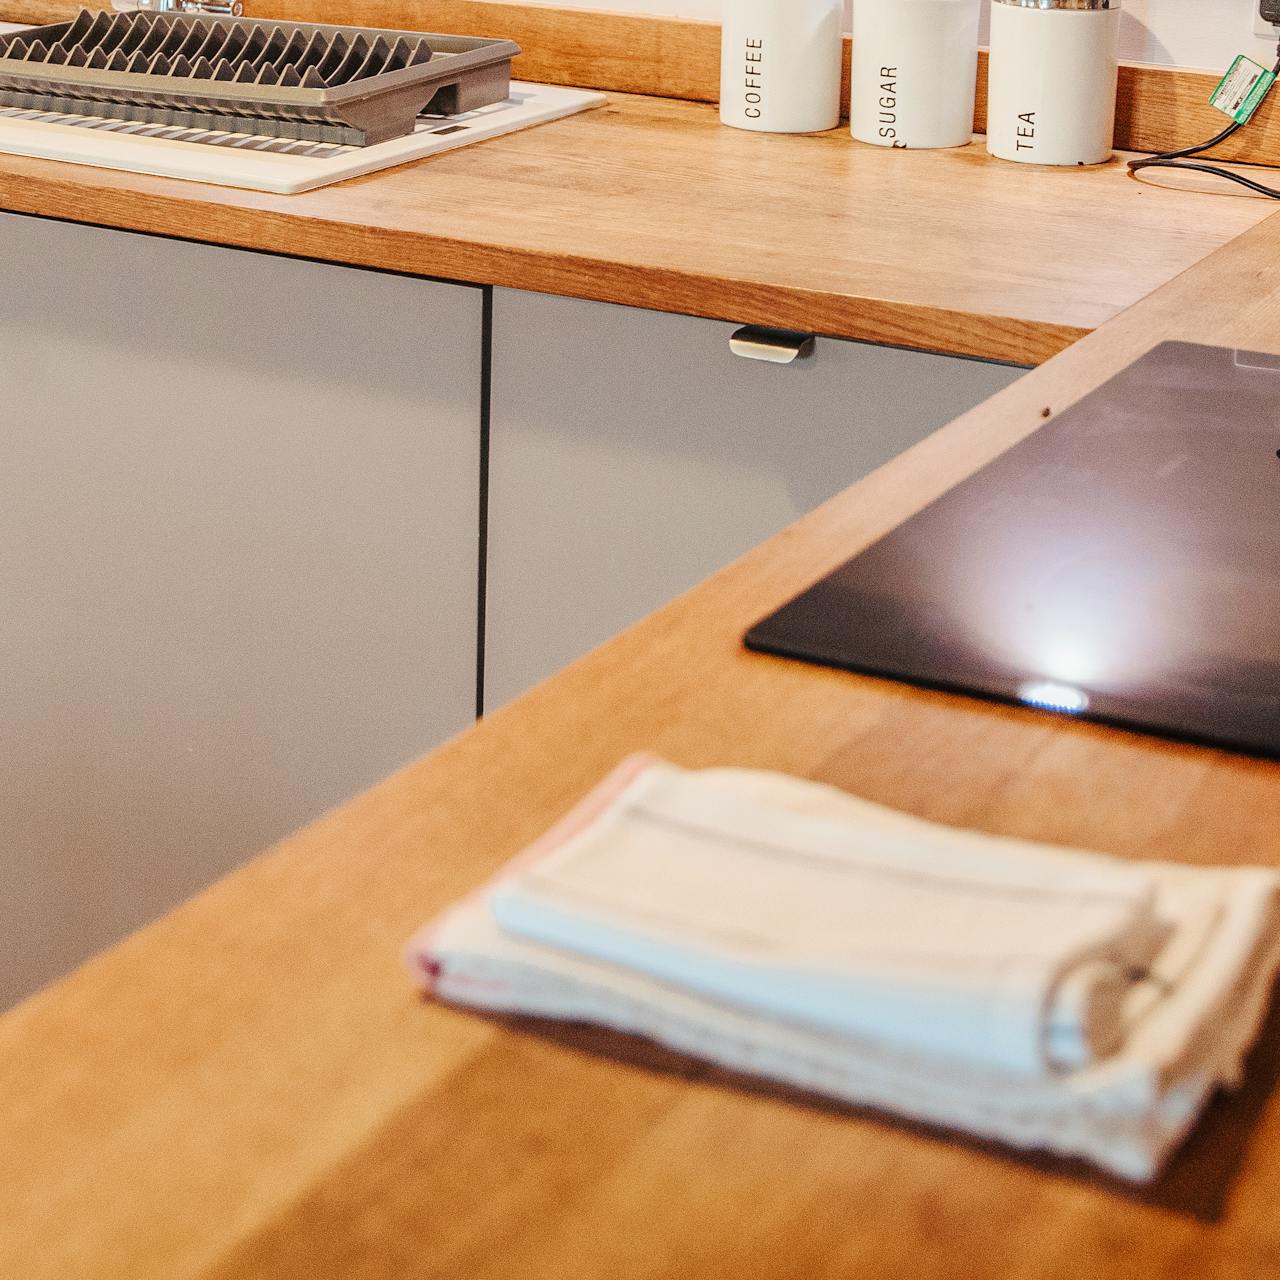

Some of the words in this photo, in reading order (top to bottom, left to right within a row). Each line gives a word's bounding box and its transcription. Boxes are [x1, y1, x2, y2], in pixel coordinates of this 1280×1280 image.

[745, 37, 762, 118] COFFEE
[879, 65, 897, 138] SUGAR
[1016, 111, 1036, 151] TEA
